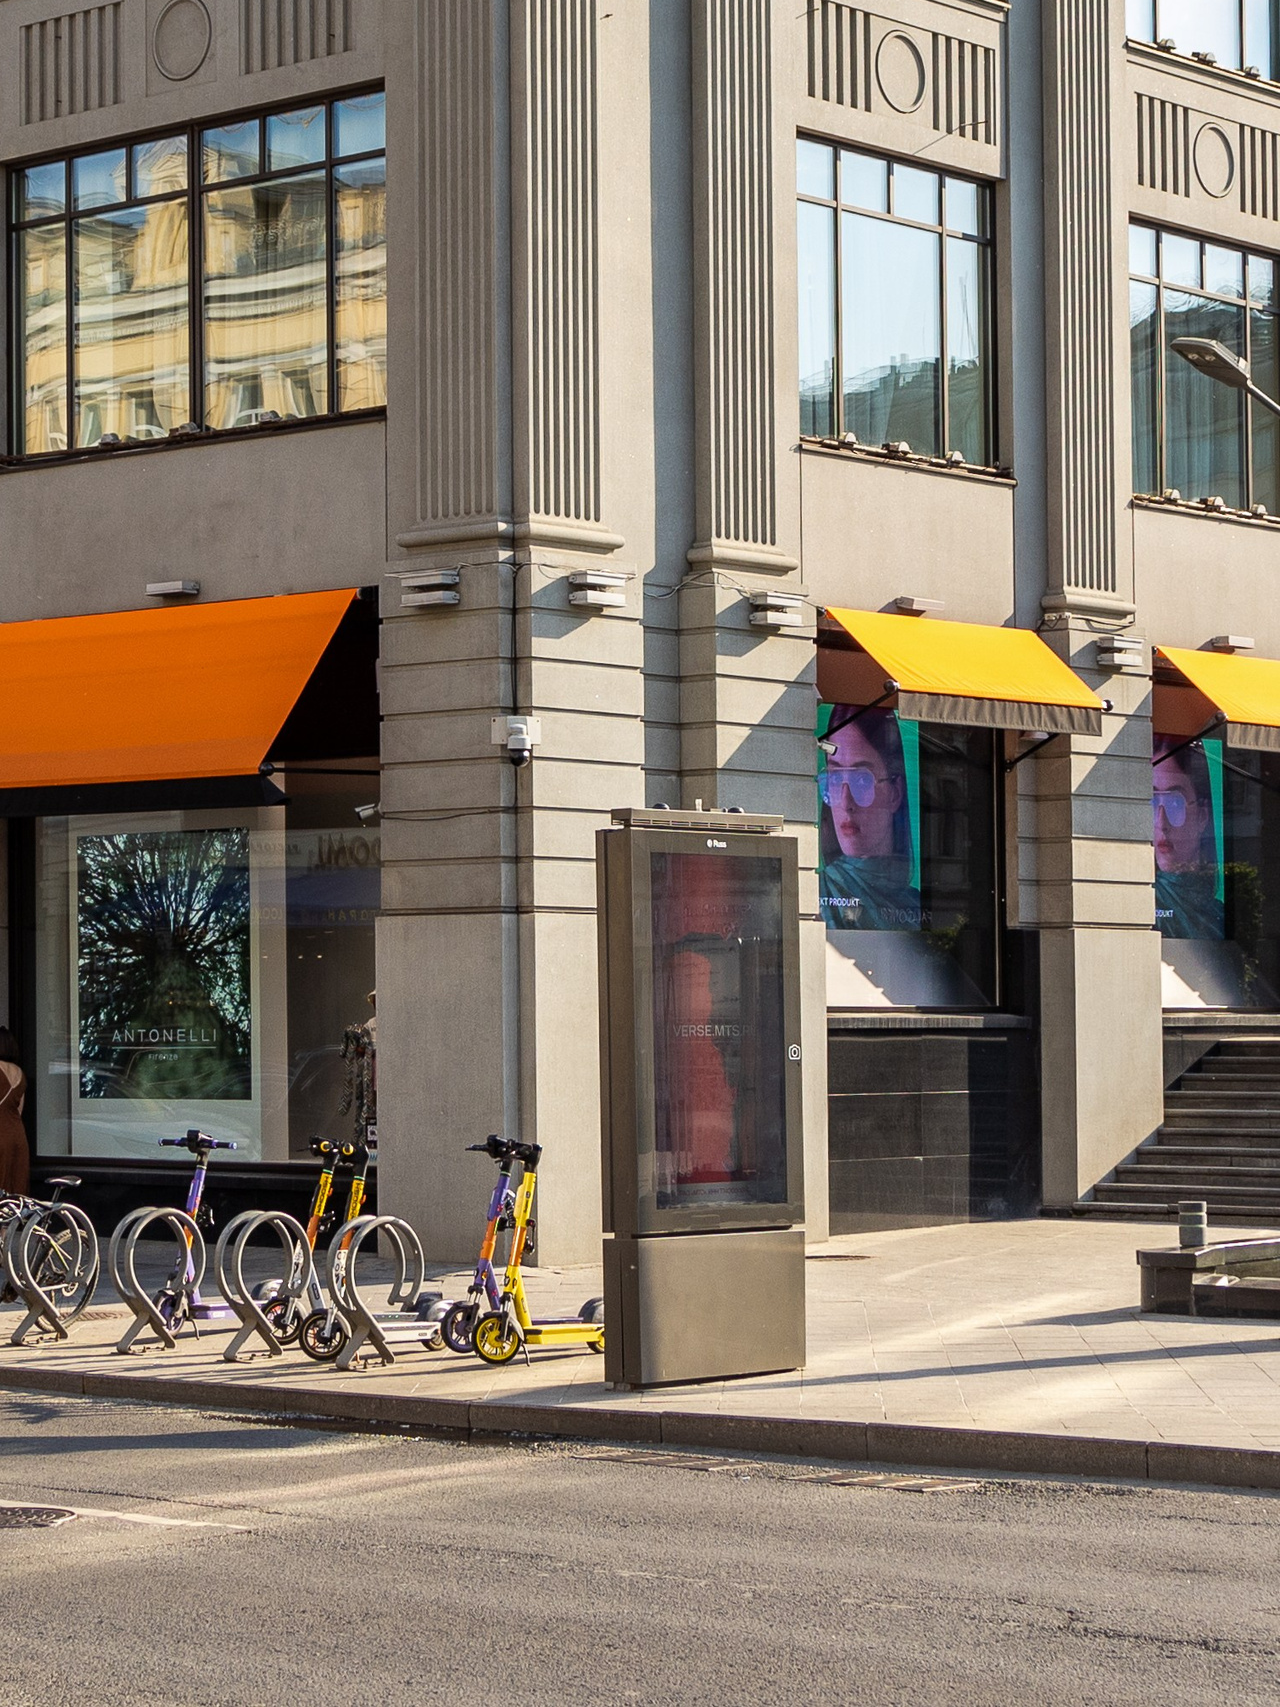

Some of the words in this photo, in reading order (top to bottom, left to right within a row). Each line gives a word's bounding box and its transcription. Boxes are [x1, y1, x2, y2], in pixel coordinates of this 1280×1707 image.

[713, 839, 727, 848] Russ
[829, 897, 860, 907] PRODUKT
[111, 1028, 217, 1042] ANTONELLI
